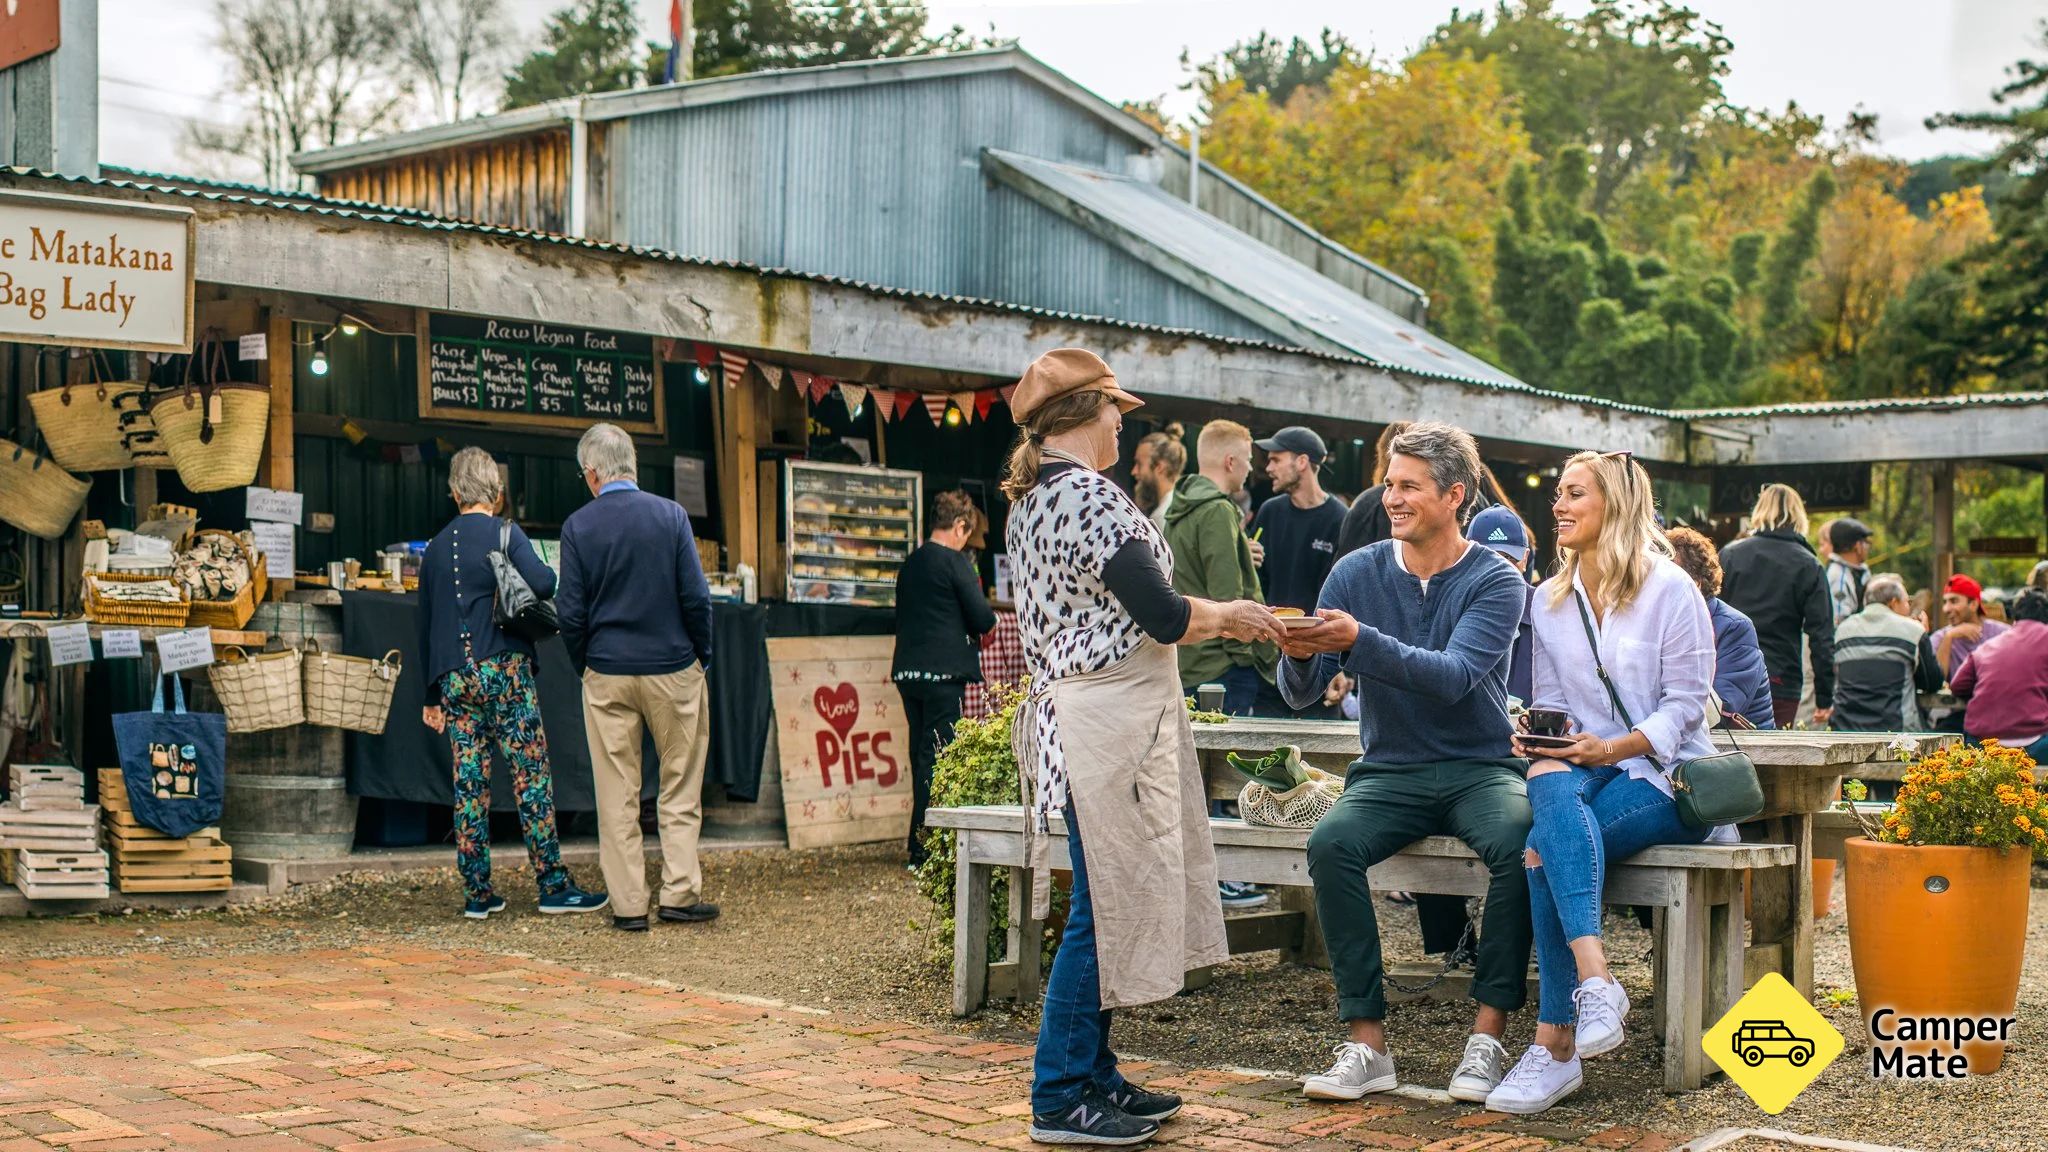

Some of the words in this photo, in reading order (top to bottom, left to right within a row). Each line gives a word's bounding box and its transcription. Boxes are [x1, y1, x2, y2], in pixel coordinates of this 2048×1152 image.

[29, 226, 174, 271] Matakana
[0, 271, 46, 320] Bag
[61, 276, 136, 328] Lady
[485, 320, 530, 339] Raw
[533, 324, 575, 349] Vegan
[584, 331, 618, 350] Food
